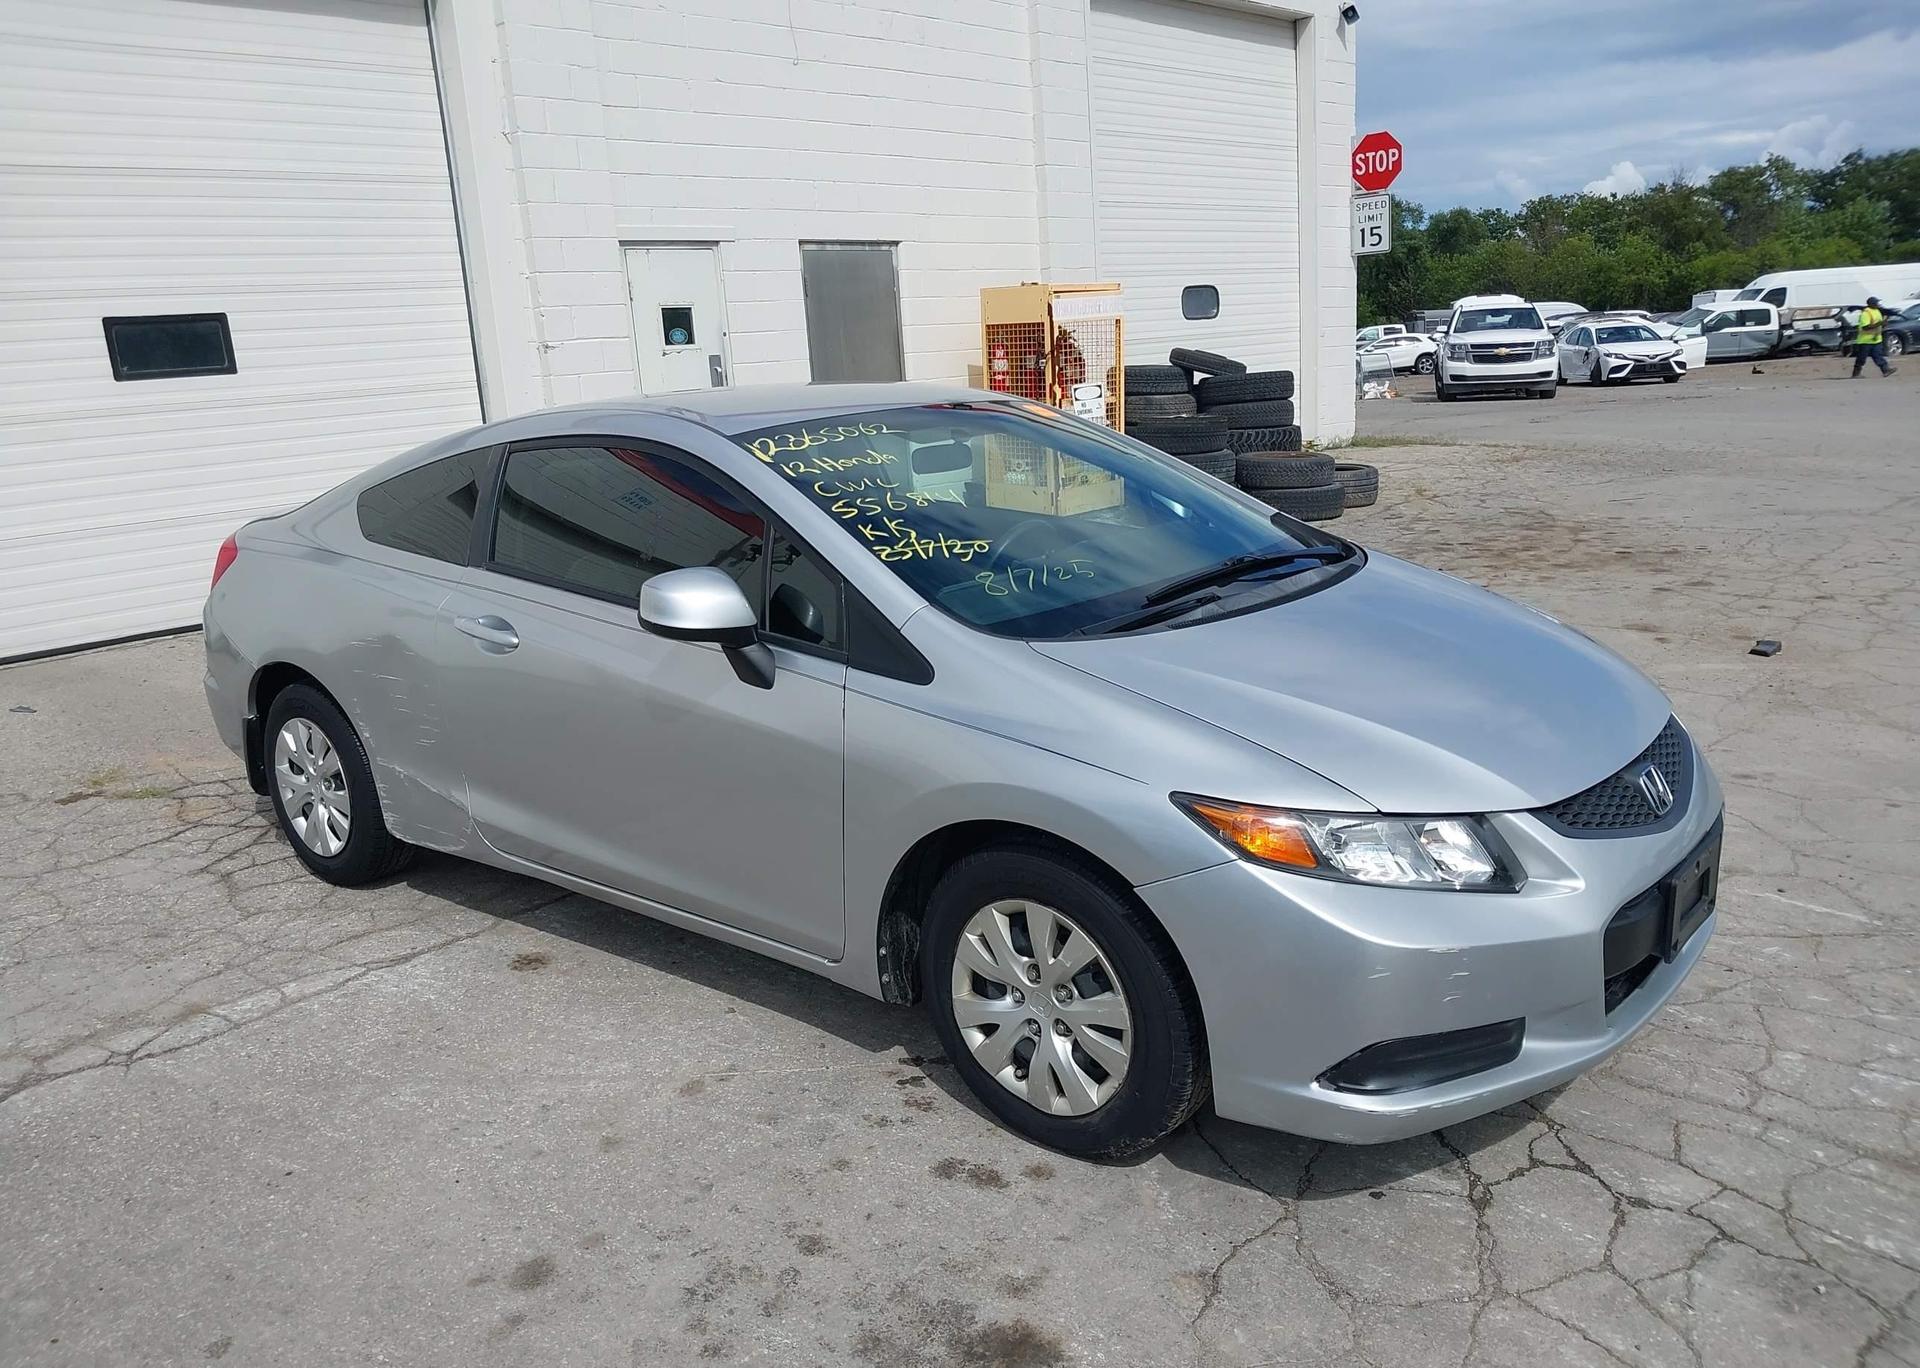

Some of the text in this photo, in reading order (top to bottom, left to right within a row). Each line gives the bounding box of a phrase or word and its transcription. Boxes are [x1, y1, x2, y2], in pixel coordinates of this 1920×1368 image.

[1355, 148, 1399, 176] STOP
[1355, 200, 1387, 212] SPEED
[1358, 212, 1384, 224] LIMIT
[1360, 225, 1383, 248] 15
[811, 449, 899, 472] Honda
